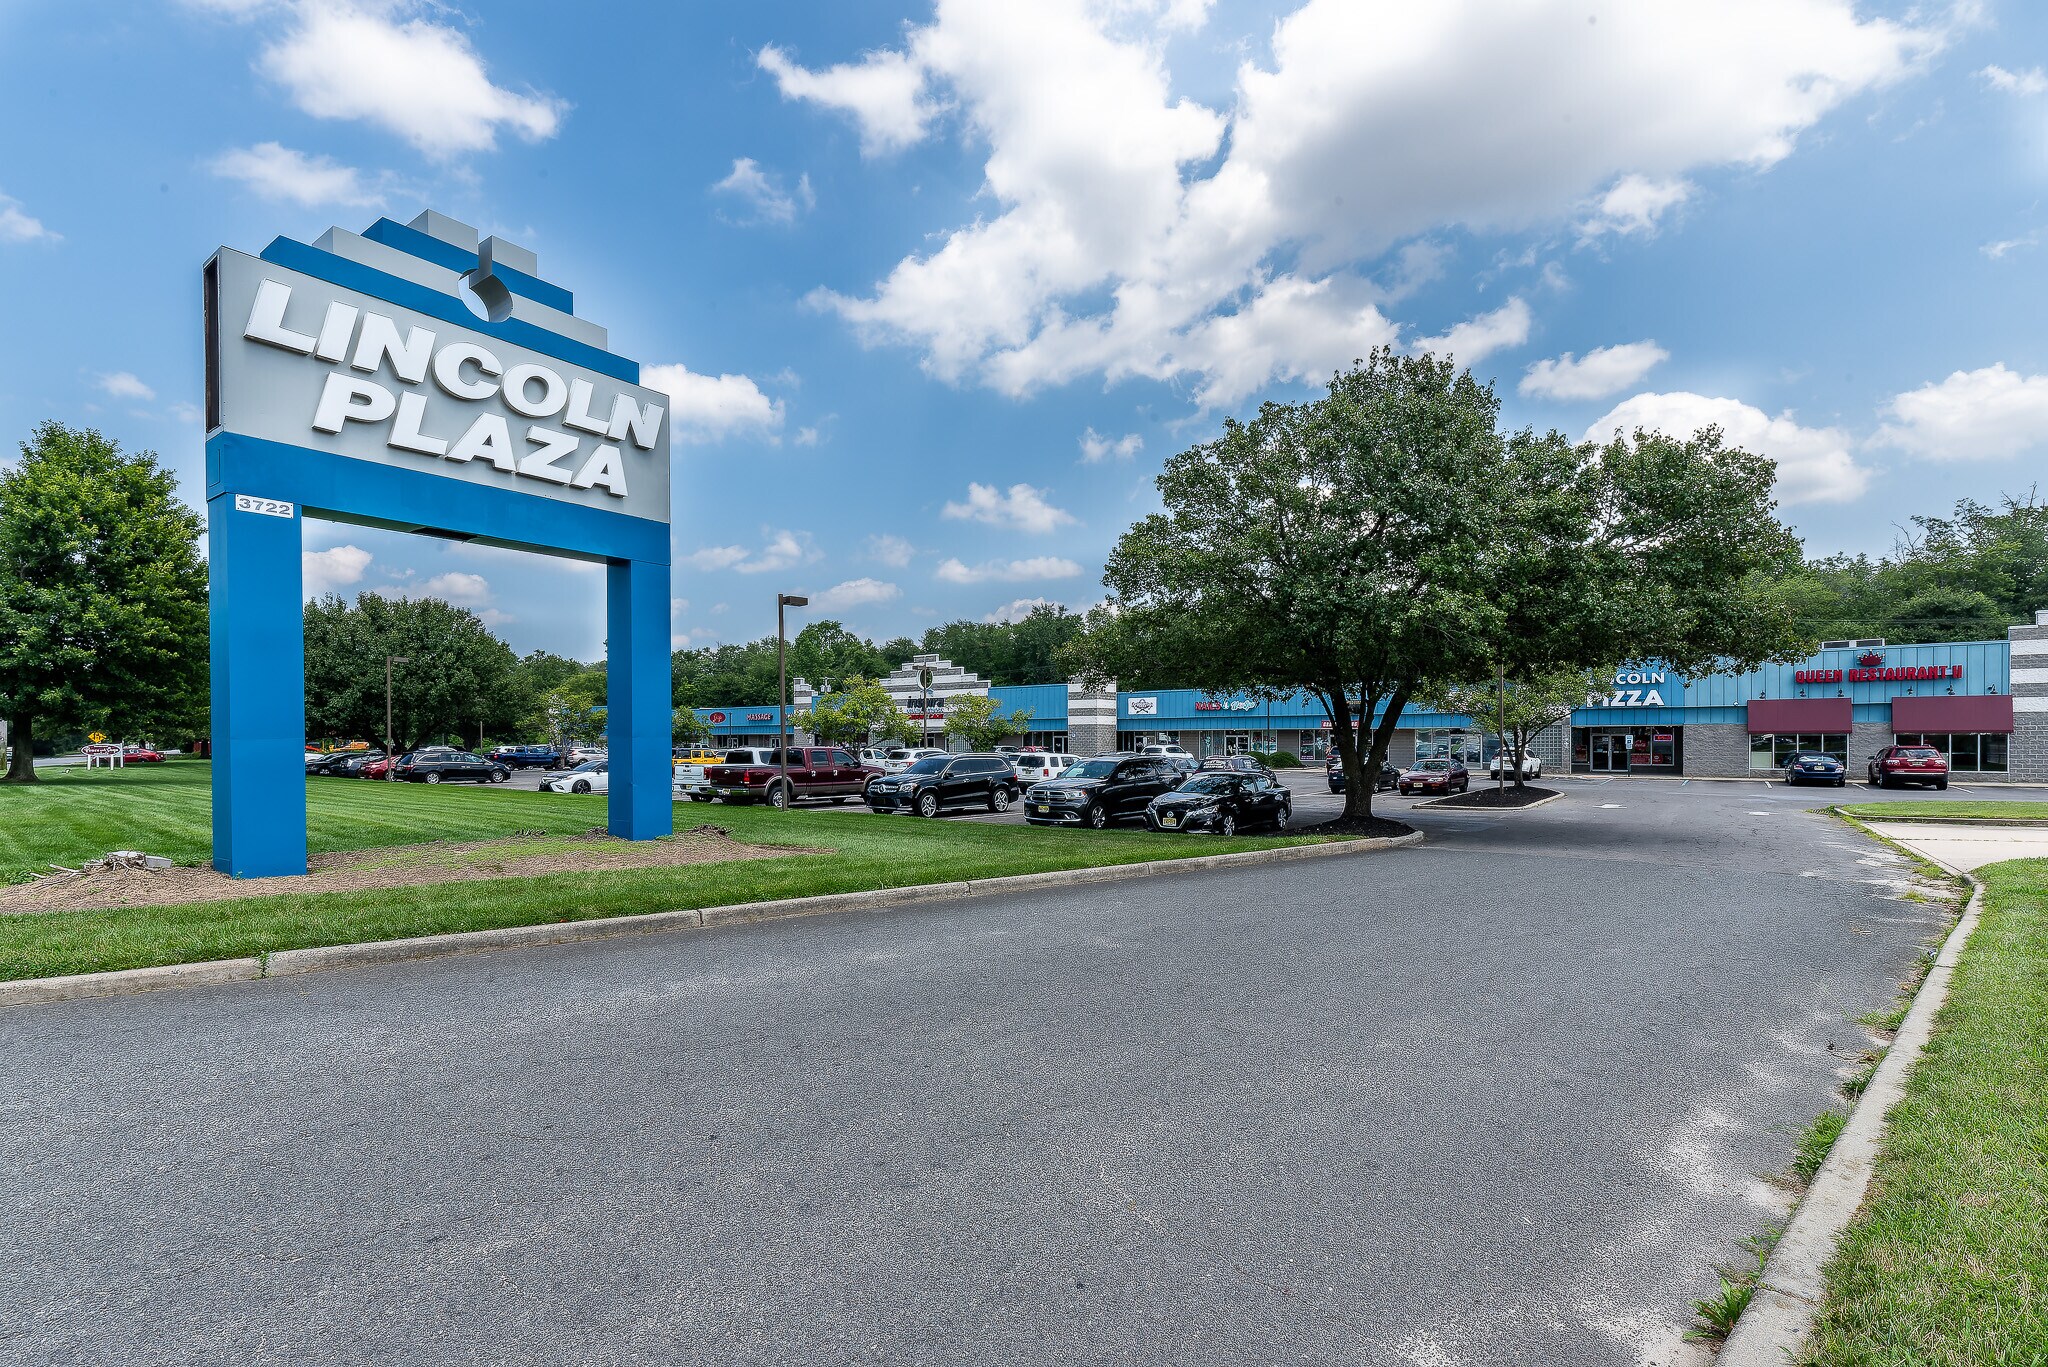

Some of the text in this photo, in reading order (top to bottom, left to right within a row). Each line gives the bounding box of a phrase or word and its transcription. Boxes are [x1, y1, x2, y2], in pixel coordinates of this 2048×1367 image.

[243, 277, 665, 450] LINCOLN
[311, 370, 629, 499] PLAZA
[239, 498, 291, 515] 3722
[1795, 669, 1843, 683] QUEEN
[1849, 665, 1948, 682] RESTAURANT
[1195, 701, 1221, 710] NAILS
[746, 713, 772, 721] MASSAGE
